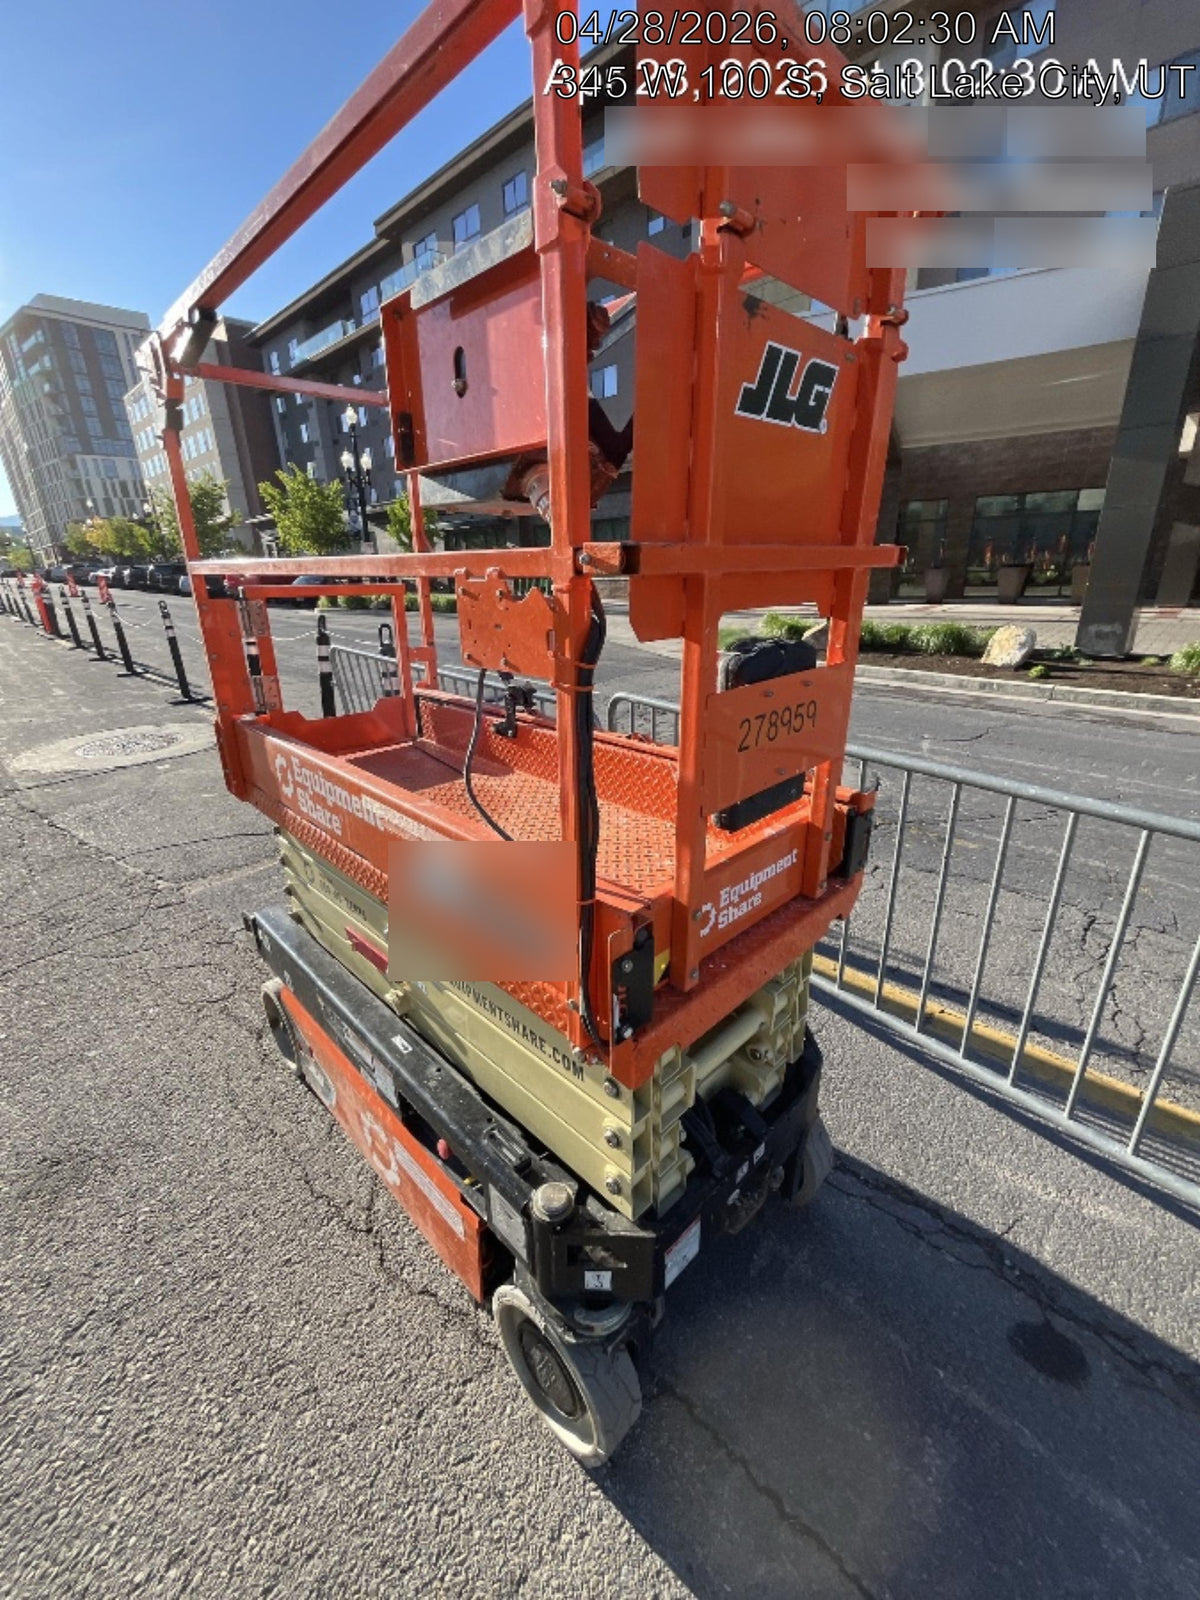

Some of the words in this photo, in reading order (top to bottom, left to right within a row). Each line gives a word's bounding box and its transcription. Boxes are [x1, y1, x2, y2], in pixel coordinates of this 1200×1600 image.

[735, 341, 840, 433] JLG
[737, 700, 817, 752] 278959
[297, 787, 342, 836] Share
[720, 848, 797, 908] Equipment
[718, 892, 762, 929] Share
[449, 981, 584, 1081] UIPMENTSHARE.COM
